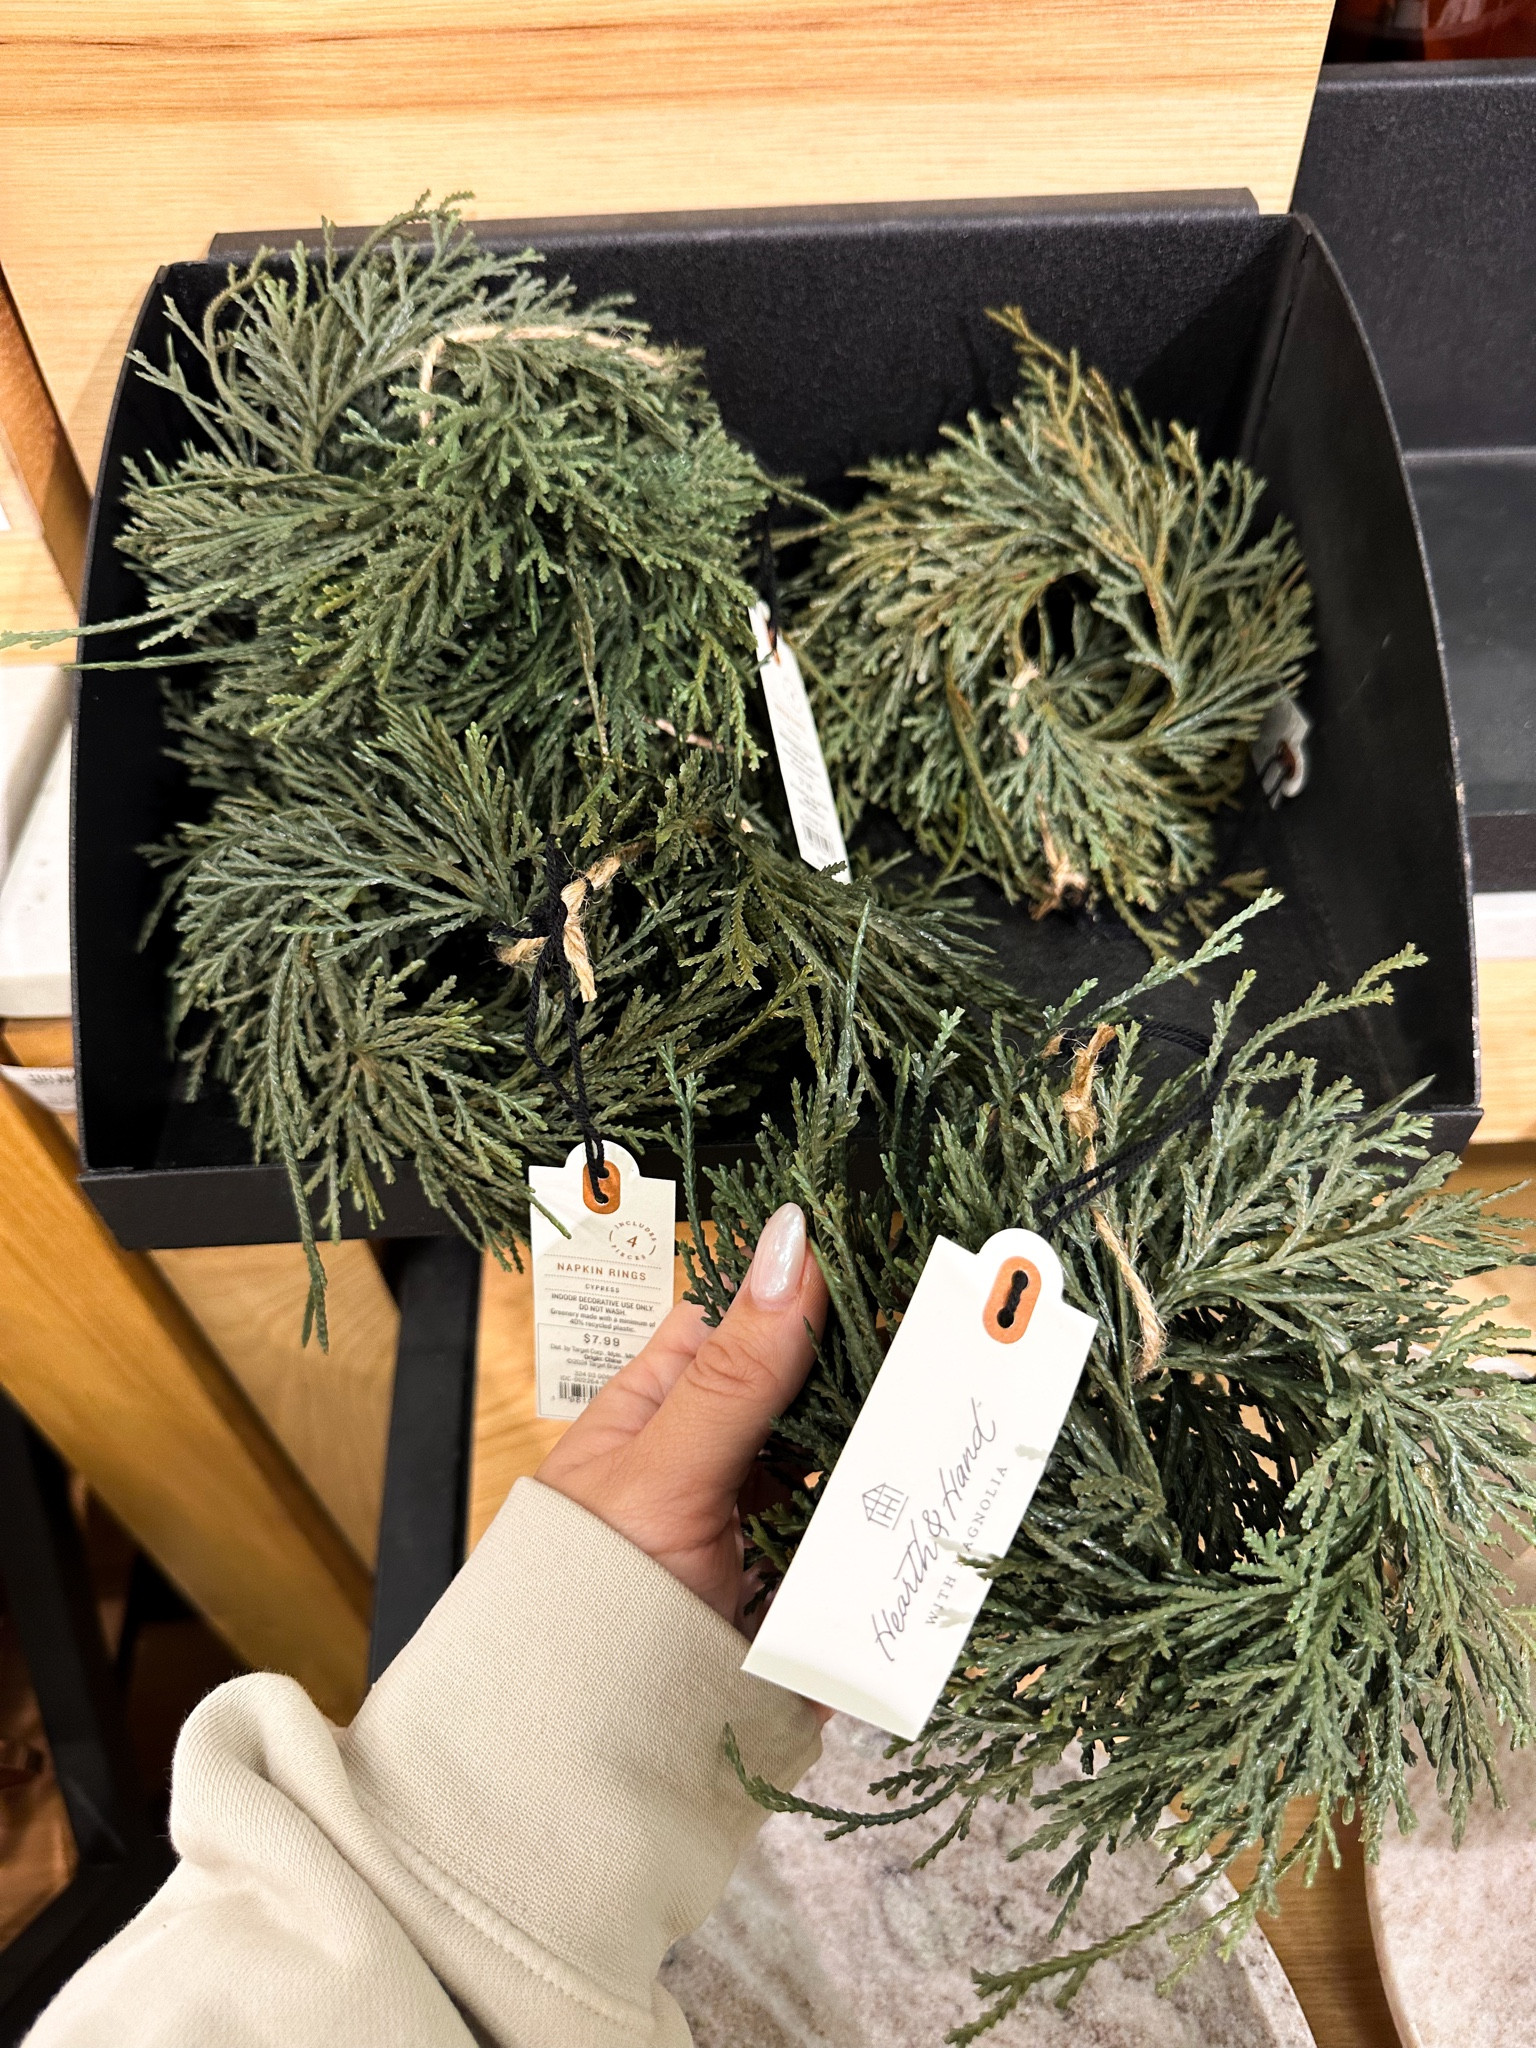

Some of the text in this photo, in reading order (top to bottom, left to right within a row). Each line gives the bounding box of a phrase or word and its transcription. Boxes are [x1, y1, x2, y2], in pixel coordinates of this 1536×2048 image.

[614, 1220, 657, 1242] INCLUDES
[626, 1235, 638, 1248] 4
[611, 1244, 646, 1261] PIECES
[557, 1262, 646, 1281] NAPKIN RINGS
[585, 1283, 620, 1293] CYPRESS
[551, 1292, 654, 1312] INDOOR DECORATIVE USE ONLY.
[579, 1303, 626, 1316] DO NOT WASH.
[550, 1308, 579, 1319] Greenery
[580, 1312, 597, 1320] made
[619, 1317, 648, 1326] minimum
[585, 1321, 613, 1330] recycled
[583, 1333, 620, 1347] $7.99
[572, 1346, 590, 1354] Target
[589, 1361, 607, 1369] Target
[871, 1397, 996, 1662] Hearth & Hand
[925, 1464, 1008, 1625] WITH AGNOLIA
